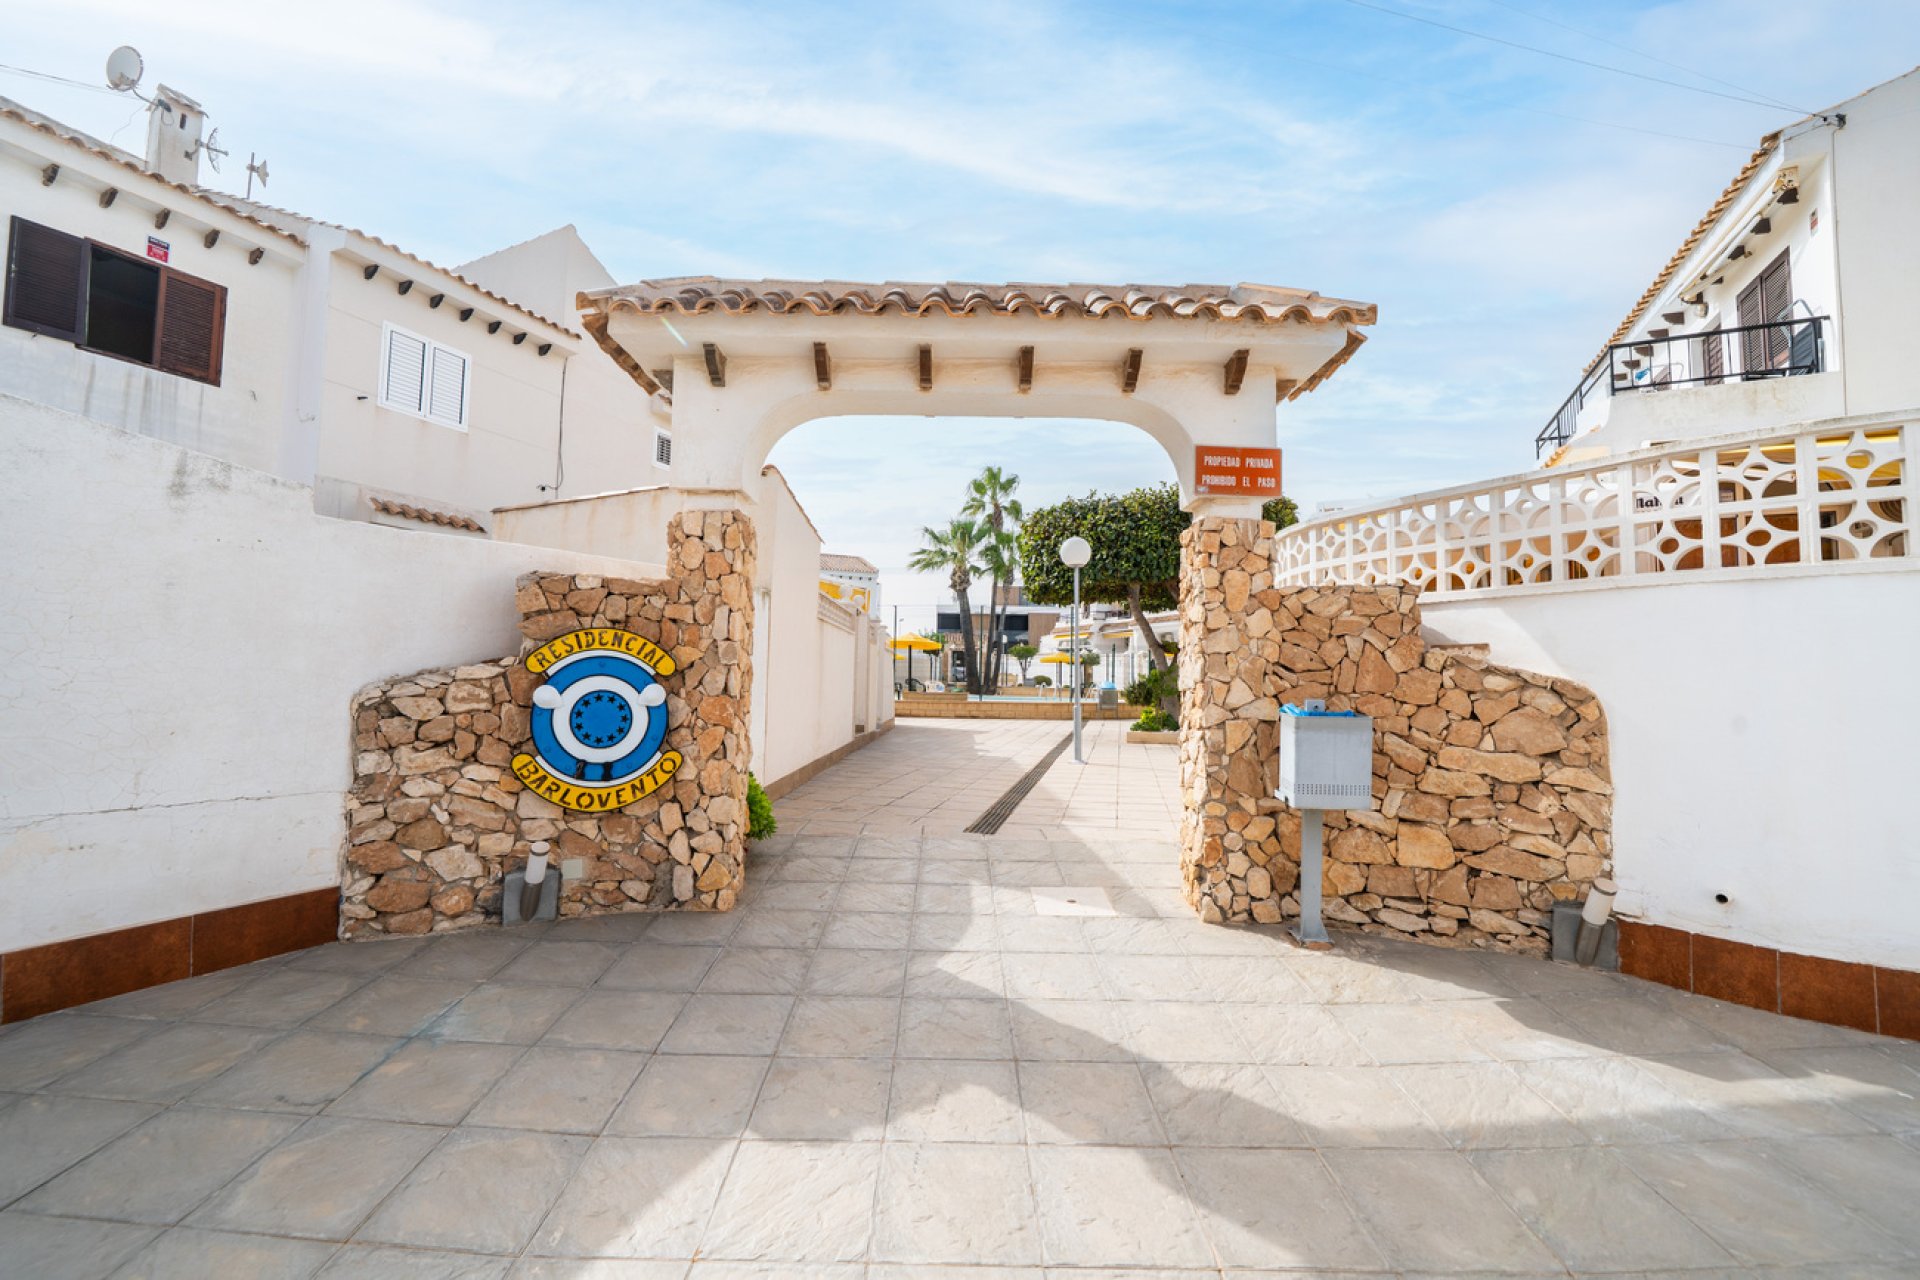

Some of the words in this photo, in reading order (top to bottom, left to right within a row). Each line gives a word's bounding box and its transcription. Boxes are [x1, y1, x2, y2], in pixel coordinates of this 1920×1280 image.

[1204, 455, 1241, 467] PROPIEDAD
[1246, 457, 1274, 468] PRIVADA
[1201, 474, 1236, 486] PROHIBIDO
[1242, 476, 1251, 487] EL
[1257, 477, 1276, 488] PASO
[533, 630, 666, 671] RESIDENCIAL
[516, 757, 677, 810] BARLOVENTO
